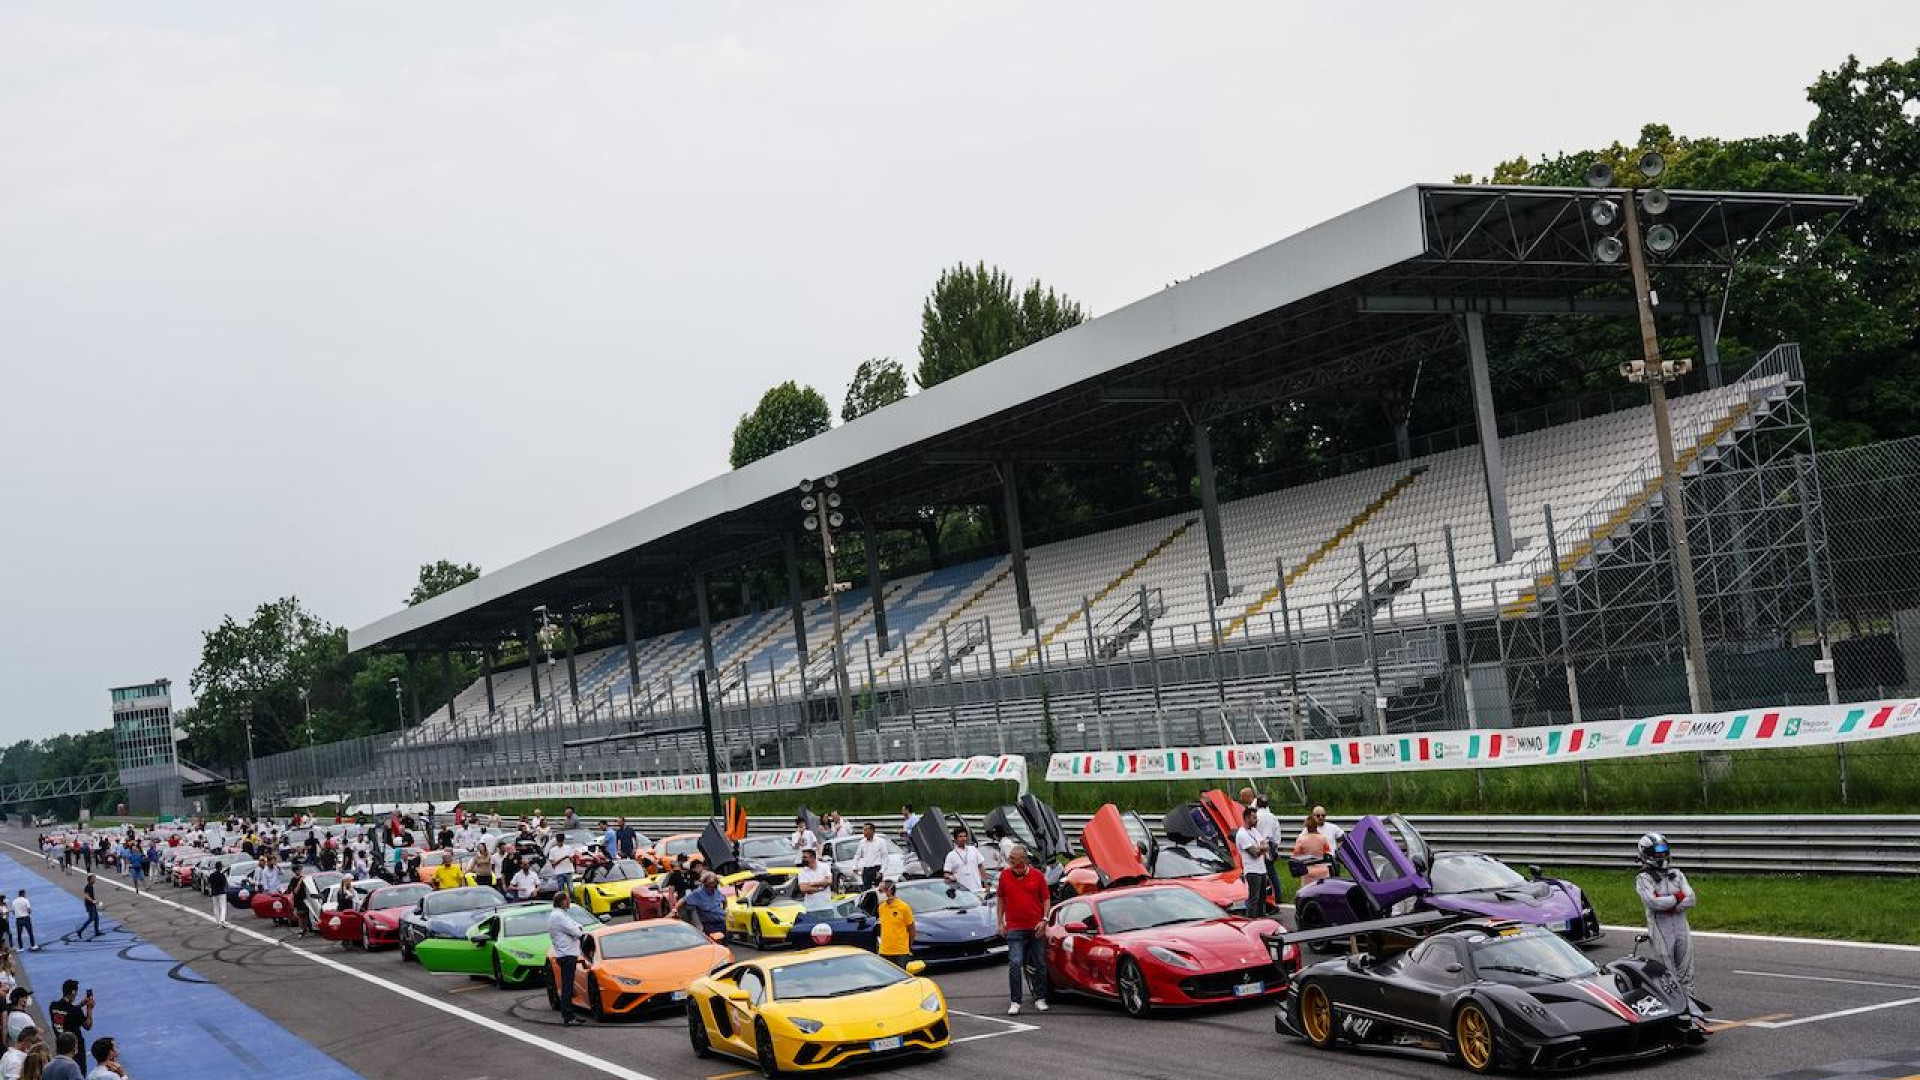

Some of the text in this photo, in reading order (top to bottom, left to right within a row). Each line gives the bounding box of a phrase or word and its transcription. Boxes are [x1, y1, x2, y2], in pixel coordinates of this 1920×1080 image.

[1689, 720, 1725, 736] MIMO
[1373, 742, 1396, 758] MIMO
[1517, 735, 1543, 752] MIMO
